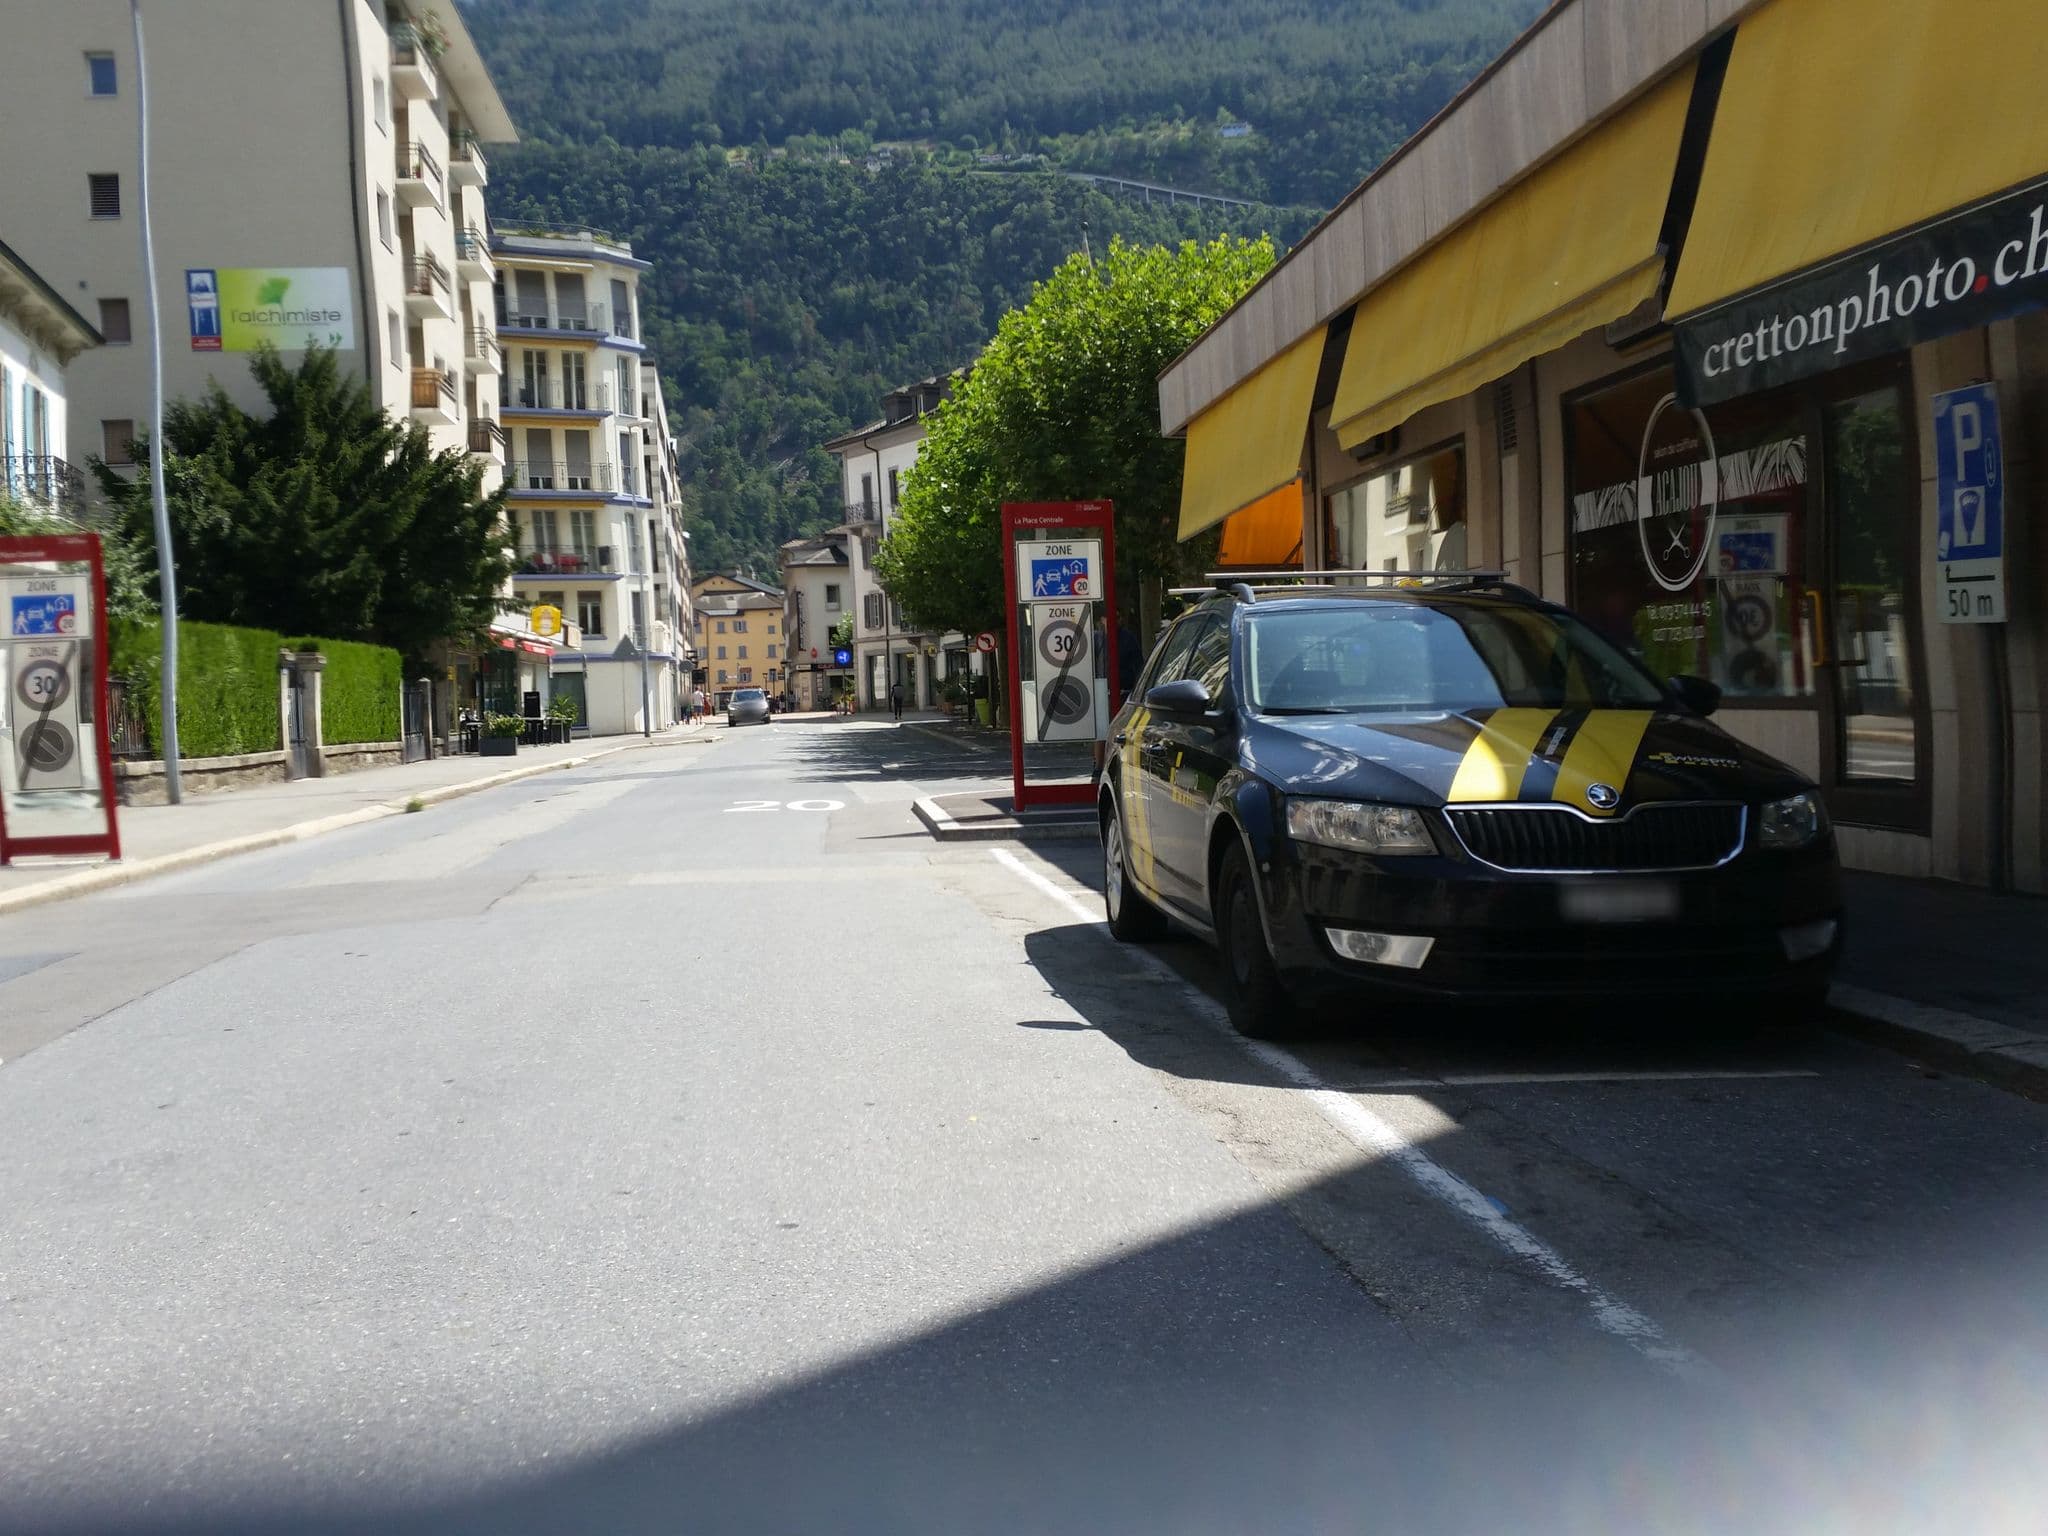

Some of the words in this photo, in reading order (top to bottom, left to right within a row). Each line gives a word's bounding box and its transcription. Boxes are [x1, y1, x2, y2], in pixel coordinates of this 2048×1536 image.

[231, 309, 341, 323] l'alchimiste
[1045, 545, 1072, 555] ZONE
[27, 581, 56, 592] ZONE
[1077, 581, 1088, 591] 20
[1949, 590, 1971, 617] 50
[1977, 592, 1994, 616] m
[1049, 608, 1075, 618] ZONE
[1054, 635, 1073, 653] 30
[28, 647, 58, 657] ZONE
[33, 676, 54, 695] 30
[723, 799, 845, 812] 20
